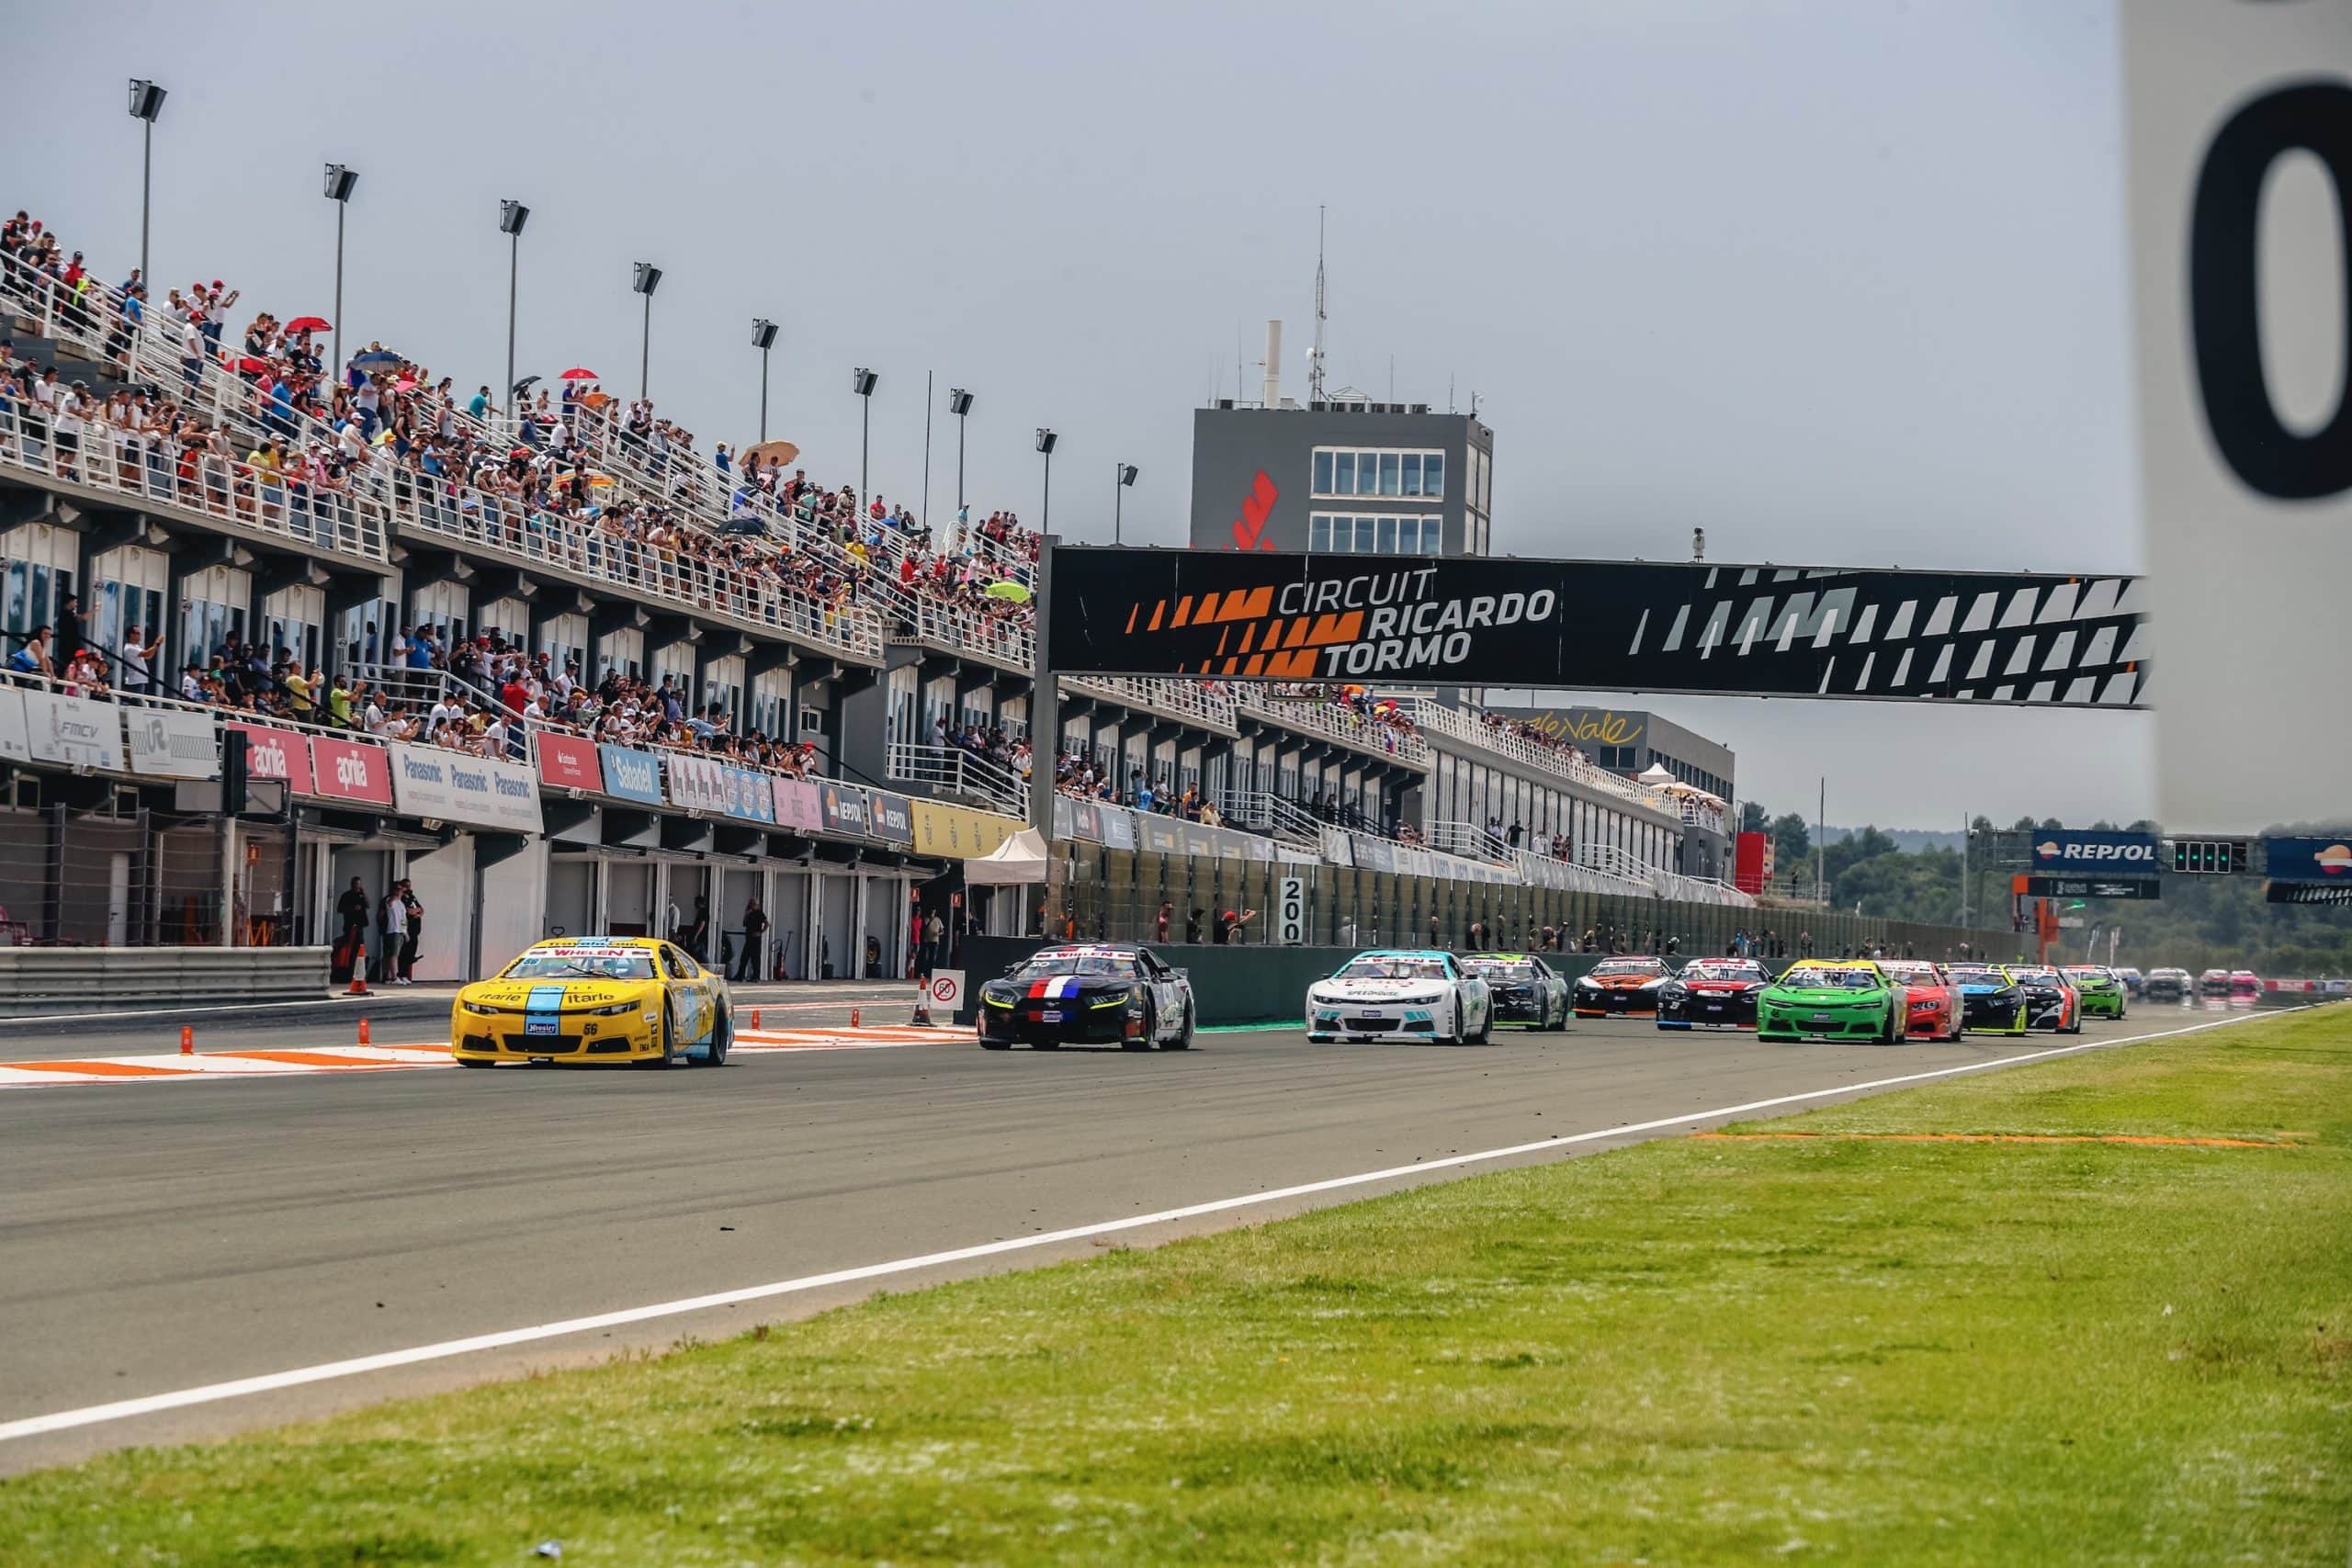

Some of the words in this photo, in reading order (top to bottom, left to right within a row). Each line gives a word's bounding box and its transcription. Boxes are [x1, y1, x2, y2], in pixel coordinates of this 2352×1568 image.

[1278, 568, 1438, 615] CIRCUIT
[1367, 588, 1555, 639] RICARDO
[1325, 631, 1472, 677] TORMO
[403, 753, 443, 784] Panasonic
[450, 763, 488, 793] Panasonic
[493, 771, 530, 799] Panasonic
[616, 756, 653, 795] Sabadell
[886, 808, 907, 830] REPSOL
[2064, 843, 2154, 861] REPSOL
[1285, 880, 1300, 941] 200
[583, 1022, 598, 1035] 56
